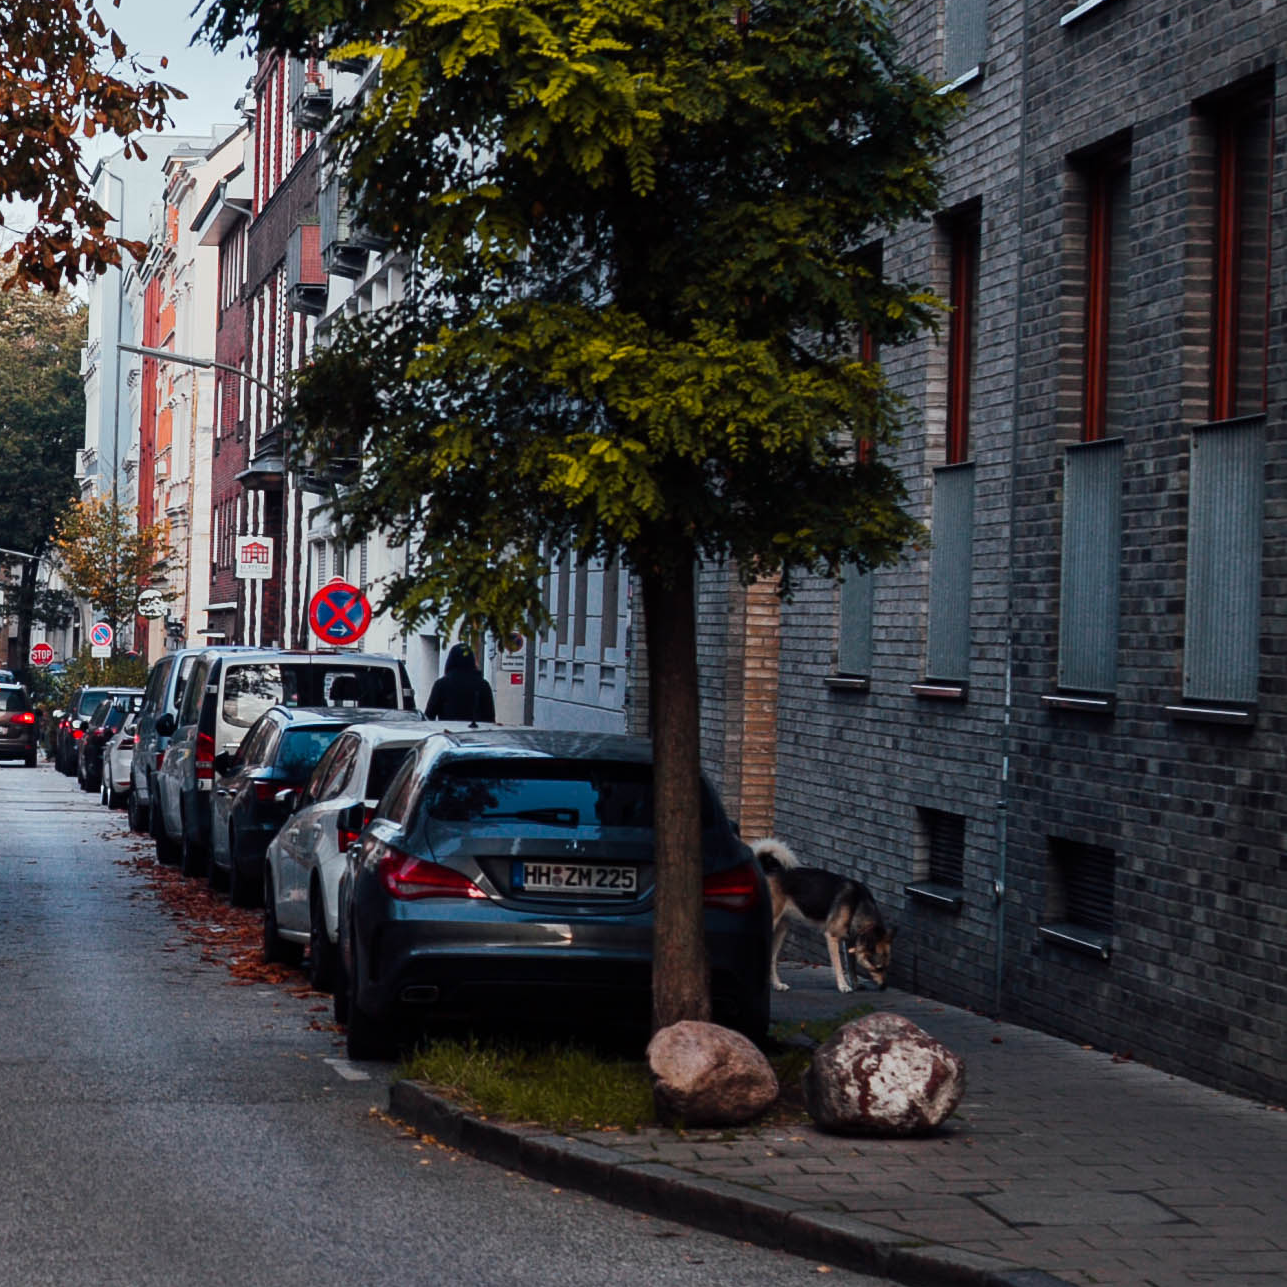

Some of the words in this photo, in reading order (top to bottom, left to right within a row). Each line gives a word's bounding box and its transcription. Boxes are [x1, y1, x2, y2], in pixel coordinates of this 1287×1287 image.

[32, 650, 51, 660] STOP
[524, 864, 551, 885] HH
[565, 866, 592, 886] ZM
[596, 868, 634, 888] 225
